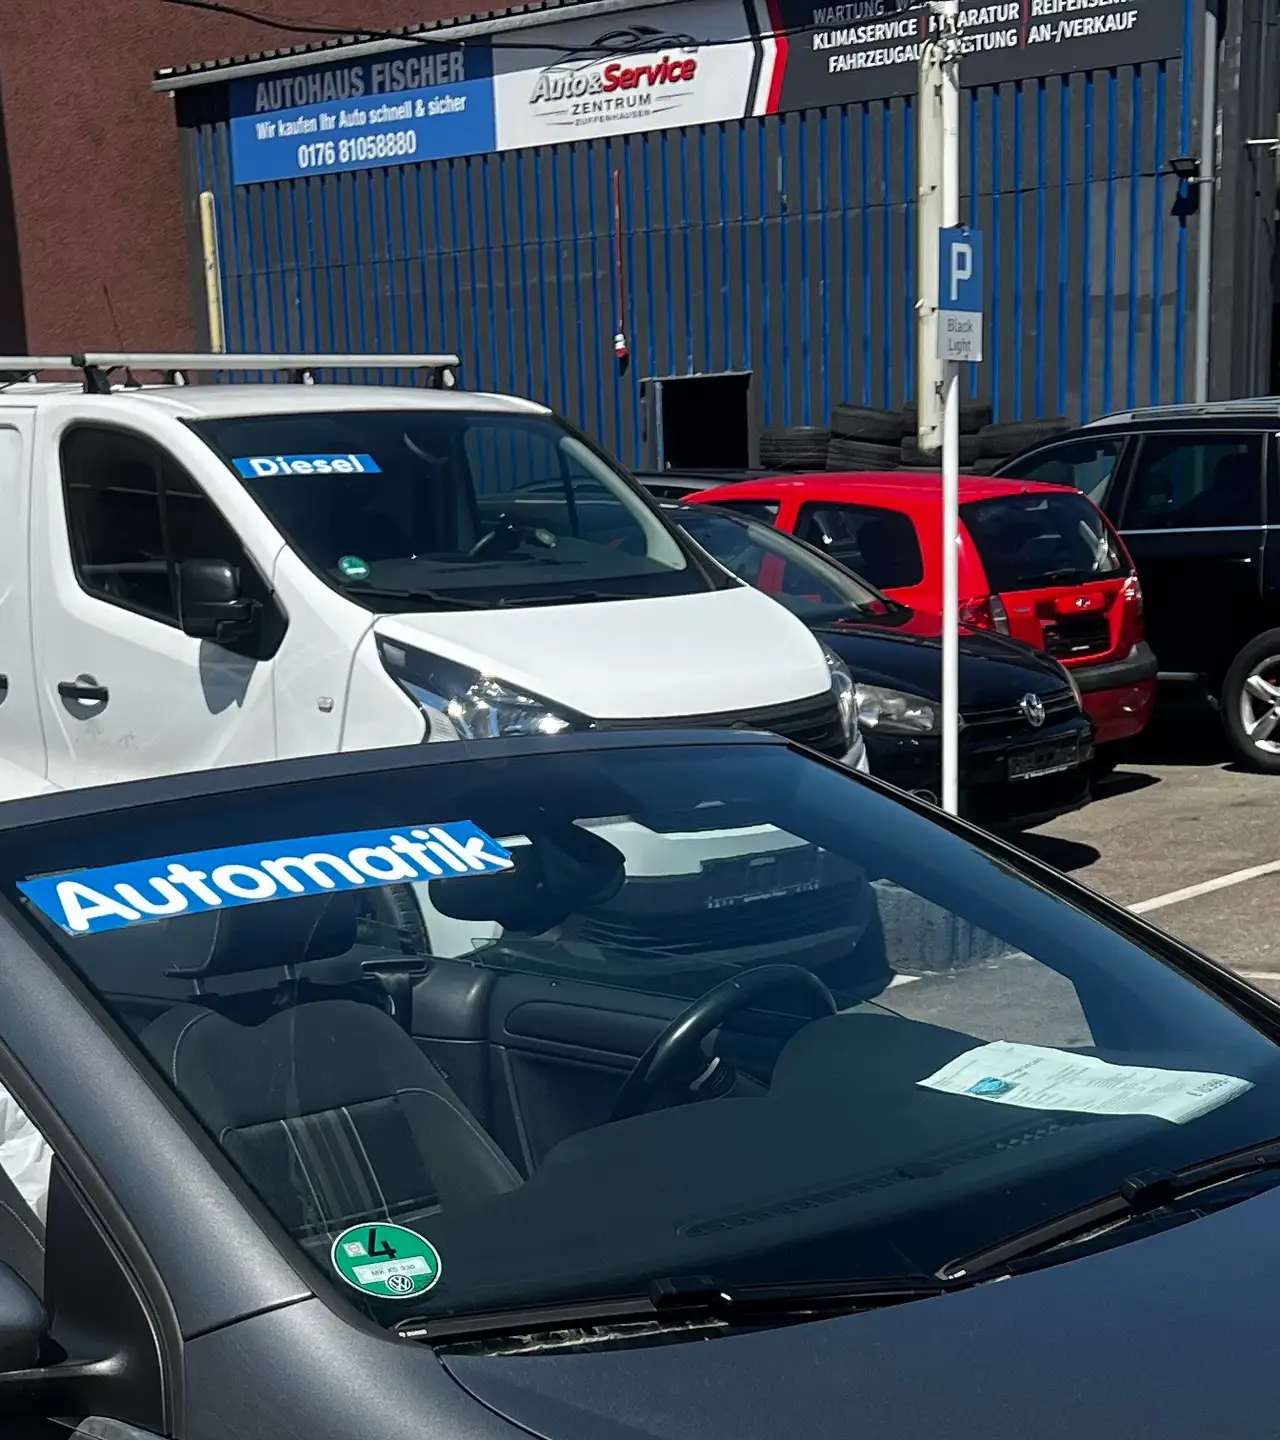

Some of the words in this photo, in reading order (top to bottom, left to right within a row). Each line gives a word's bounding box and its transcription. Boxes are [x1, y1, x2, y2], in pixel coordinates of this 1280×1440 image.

[813, 18, 918, 51] KLIMASERVICE
[1028, 10, 1138, 43] AN-/VERKAUF
[255, 66, 365, 112] AUTOHAUS
[372, 51, 465, 94] FISCHER
[255, 121, 276, 140] Wir
[278, 115, 318, 137] kaufen
[319, 112, 337, 131] Ihr
[338, 108, 366, 129] Auto
[369, 100, 412, 124] schnell
[414, 99, 426, 117] &
[427, 94, 467, 116] sicher
[572, 93, 652, 116] ZENTRUM
[297, 141, 335, 169] 0176
[338, 129, 417, 163] 81058880
[950, 242, 972, 301] P
[947, 318, 974, 332] Black
[249, 454, 365, 476] Diesel
[54, 826, 514, 931] Automatik
[368, 1228, 397, 1259] 4
